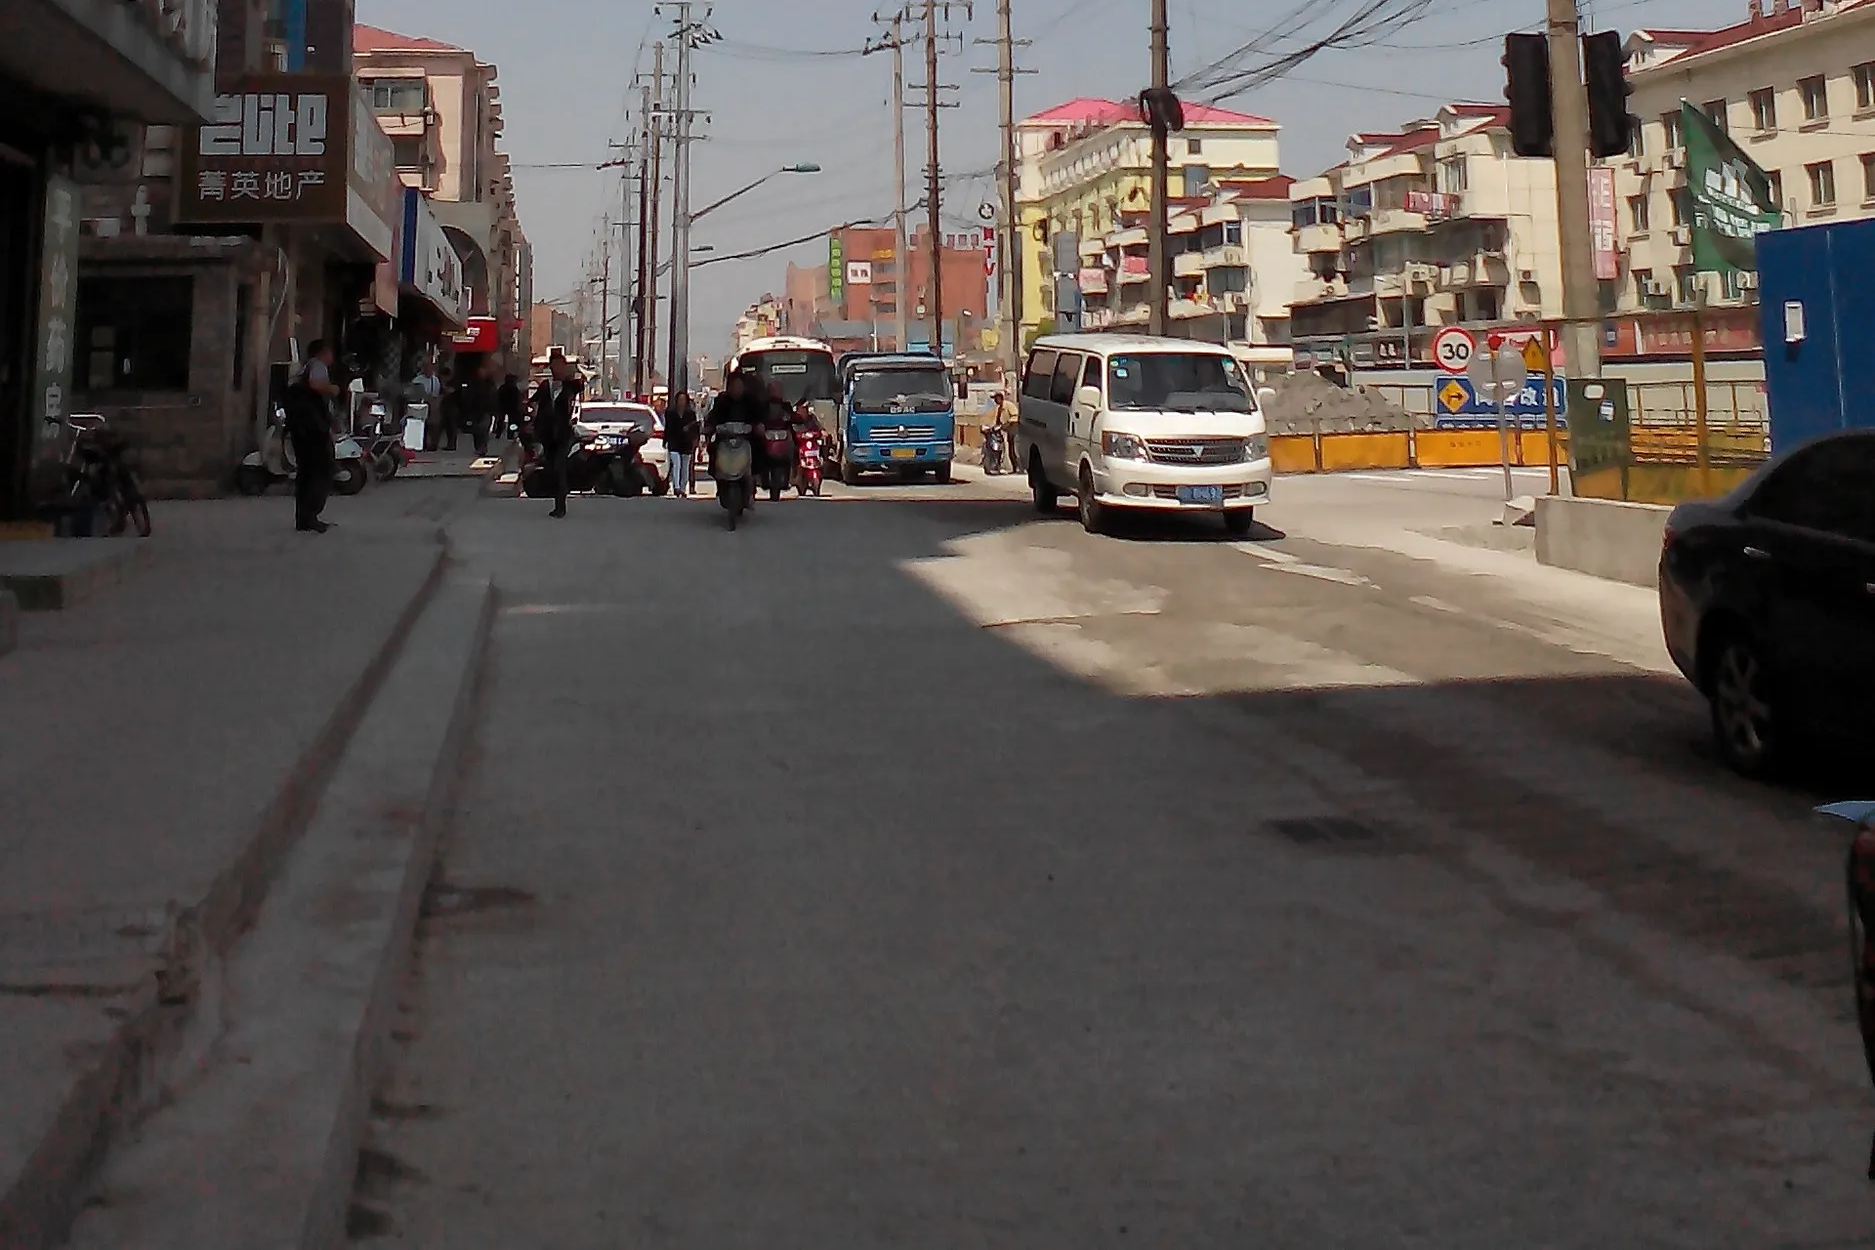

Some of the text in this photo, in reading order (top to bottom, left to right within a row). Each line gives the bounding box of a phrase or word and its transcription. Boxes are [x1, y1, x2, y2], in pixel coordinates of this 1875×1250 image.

[198, 170, 325, 200] 菁英地产
[1442, 343, 1469, 360] 30
